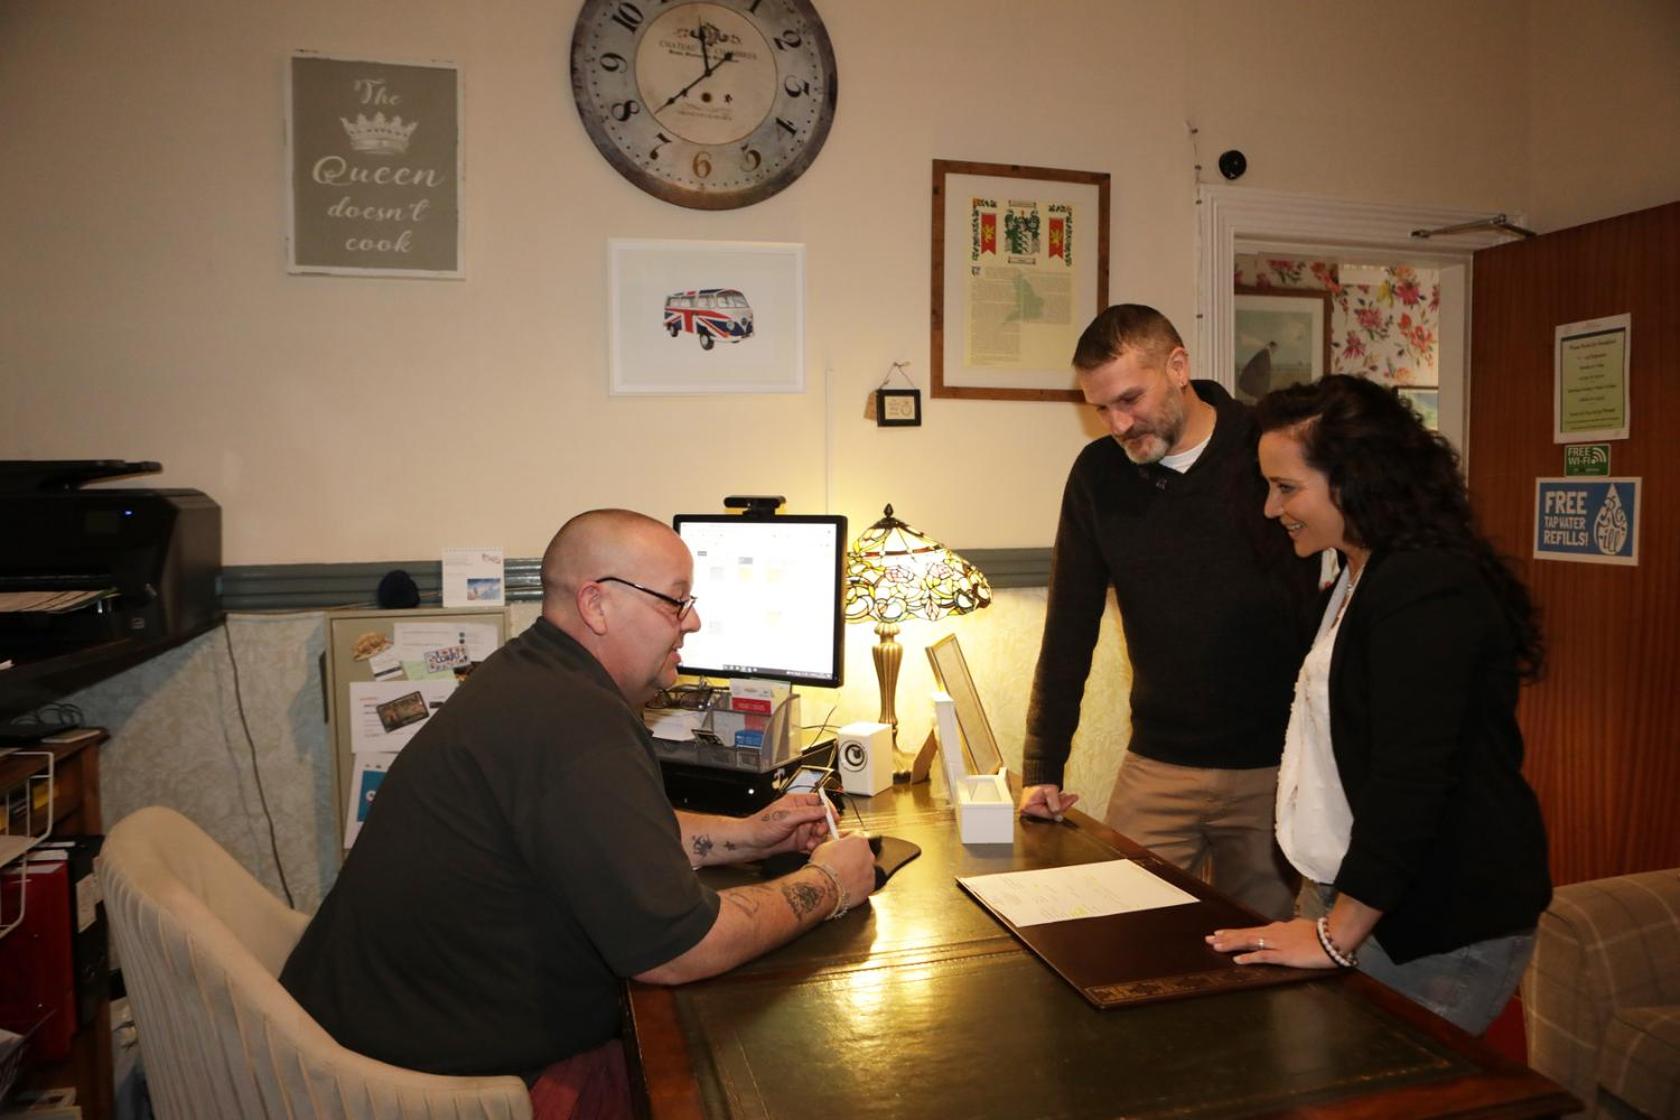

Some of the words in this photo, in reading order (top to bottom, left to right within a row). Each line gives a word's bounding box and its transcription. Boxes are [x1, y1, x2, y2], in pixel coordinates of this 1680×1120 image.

[612, 2, 644, 34] 10
[774, 29, 803, 51] 2
[599, 52, 628, 73] 9
[353, 78, 400, 106] The
[784, 75, 810, 98] 3
[611, 100, 640, 122] 8
[774, 117, 797, 141] 4
[650, 132, 672, 160] 7
[692, 151, 712, 178] 6
[740, 144, 762, 172] 5
[312, 155, 443, 187] Queen
[345, 230, 413, 253] cook
[1568, 447, 1591, 457] FREE
[1545, 491, 1588, 515] FREE
[1559, 516, 1586, 530] WATER
[1543, 530, 1589, 546] REFILLS!
